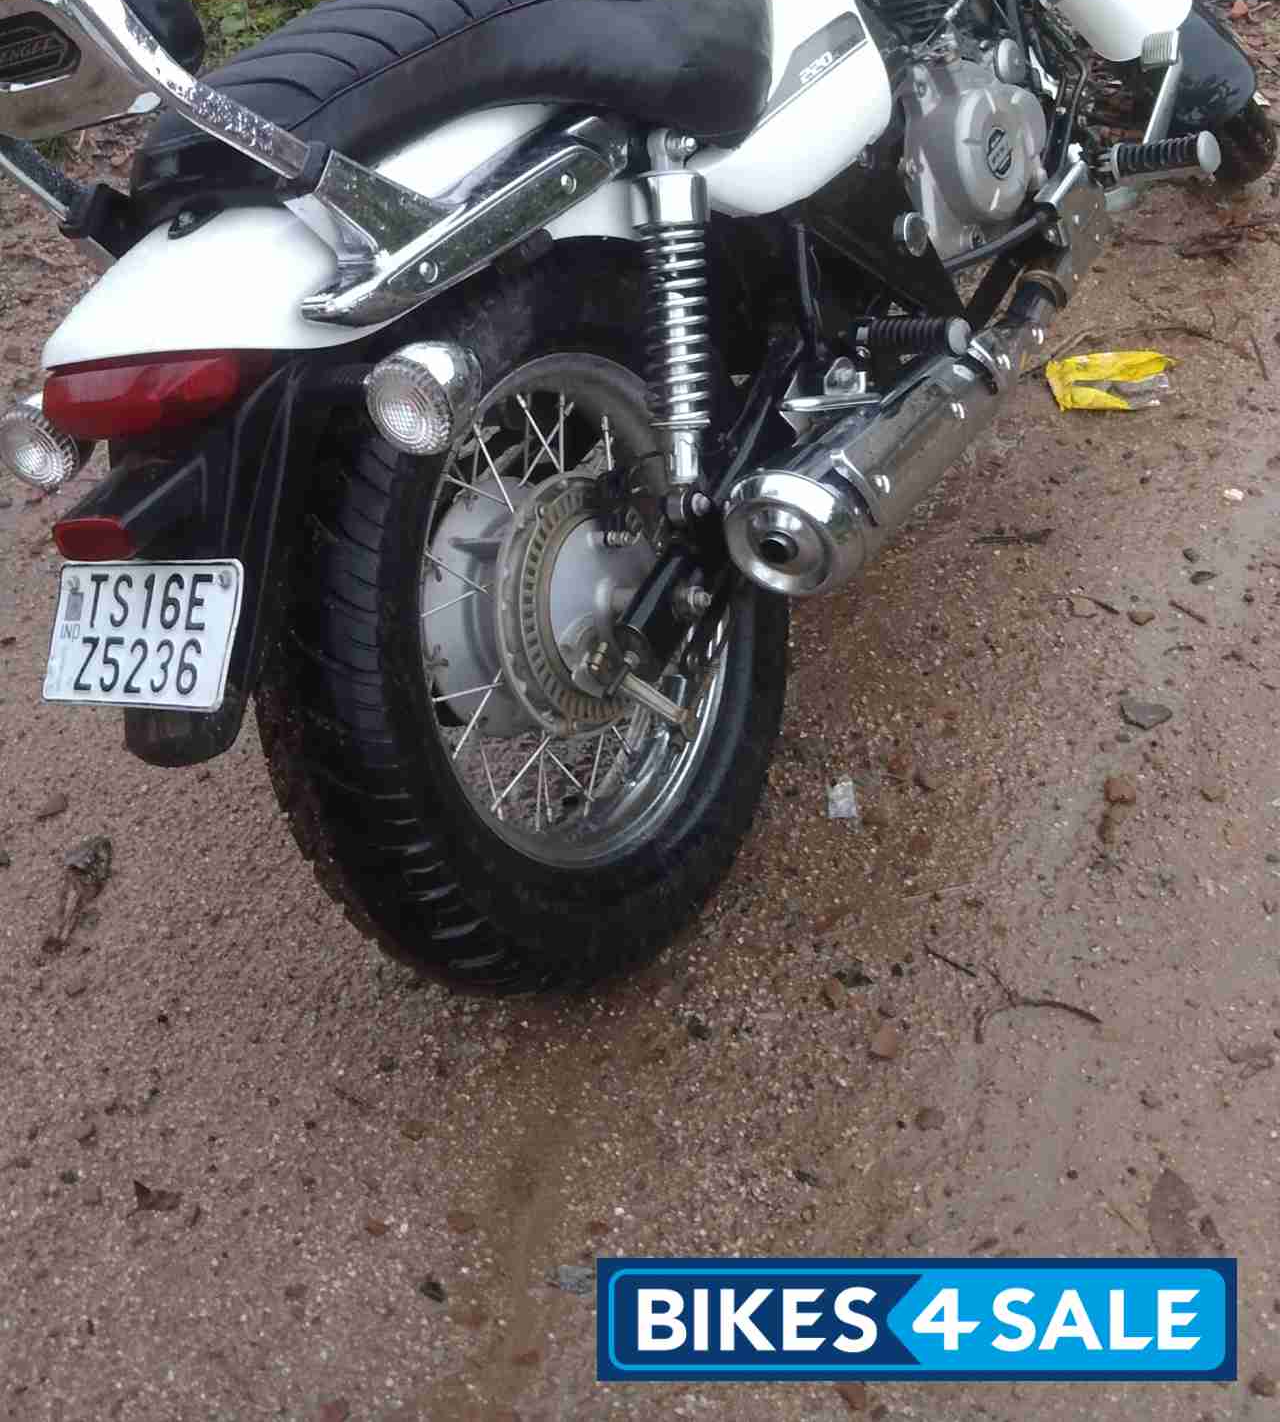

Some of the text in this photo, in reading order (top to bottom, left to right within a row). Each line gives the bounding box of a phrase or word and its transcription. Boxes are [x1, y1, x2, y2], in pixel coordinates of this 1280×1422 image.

[800, 50, 833, 84] 220
[90, 573, 214, 631] TS16E
[60, 623, 81, 641] IND
[73, 636, 203, 695] Z5236
